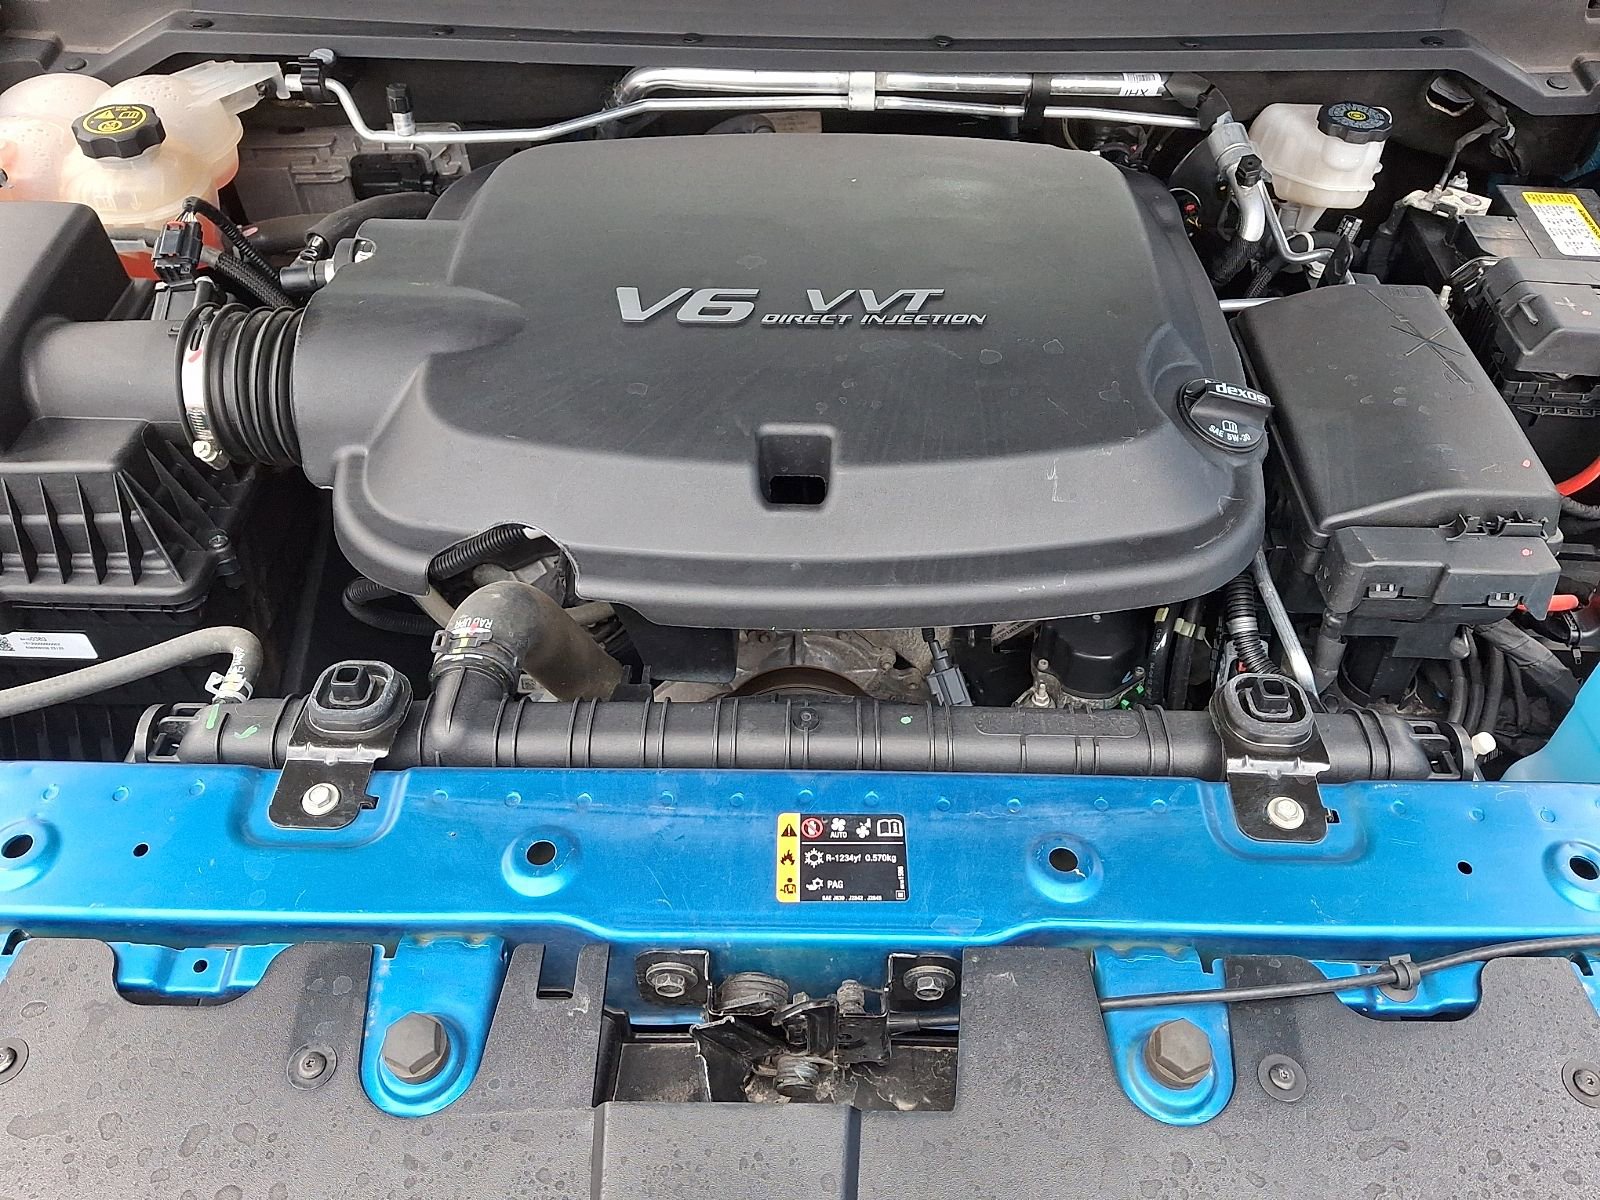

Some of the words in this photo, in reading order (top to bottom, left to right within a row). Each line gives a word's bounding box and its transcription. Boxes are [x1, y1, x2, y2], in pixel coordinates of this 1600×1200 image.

[616, 287, 760, 324] V6
[806, 288, 945, 313] VVT
[761, 313, 854, 326] DIRECT
[860, 313, 988, 326] INJECTION
[1215, 383, 1267, 405] dexos
[1208, 424, 1224, 438] SAE
[1226, 433, 1251, 442] 5W-30
[830, 831, 848, 839] AUTO
[825, 854, 861, 863] R-1234yf
[865, 854, 897, 863] 0.570kg
[827, 880, 844, 889] PAG
